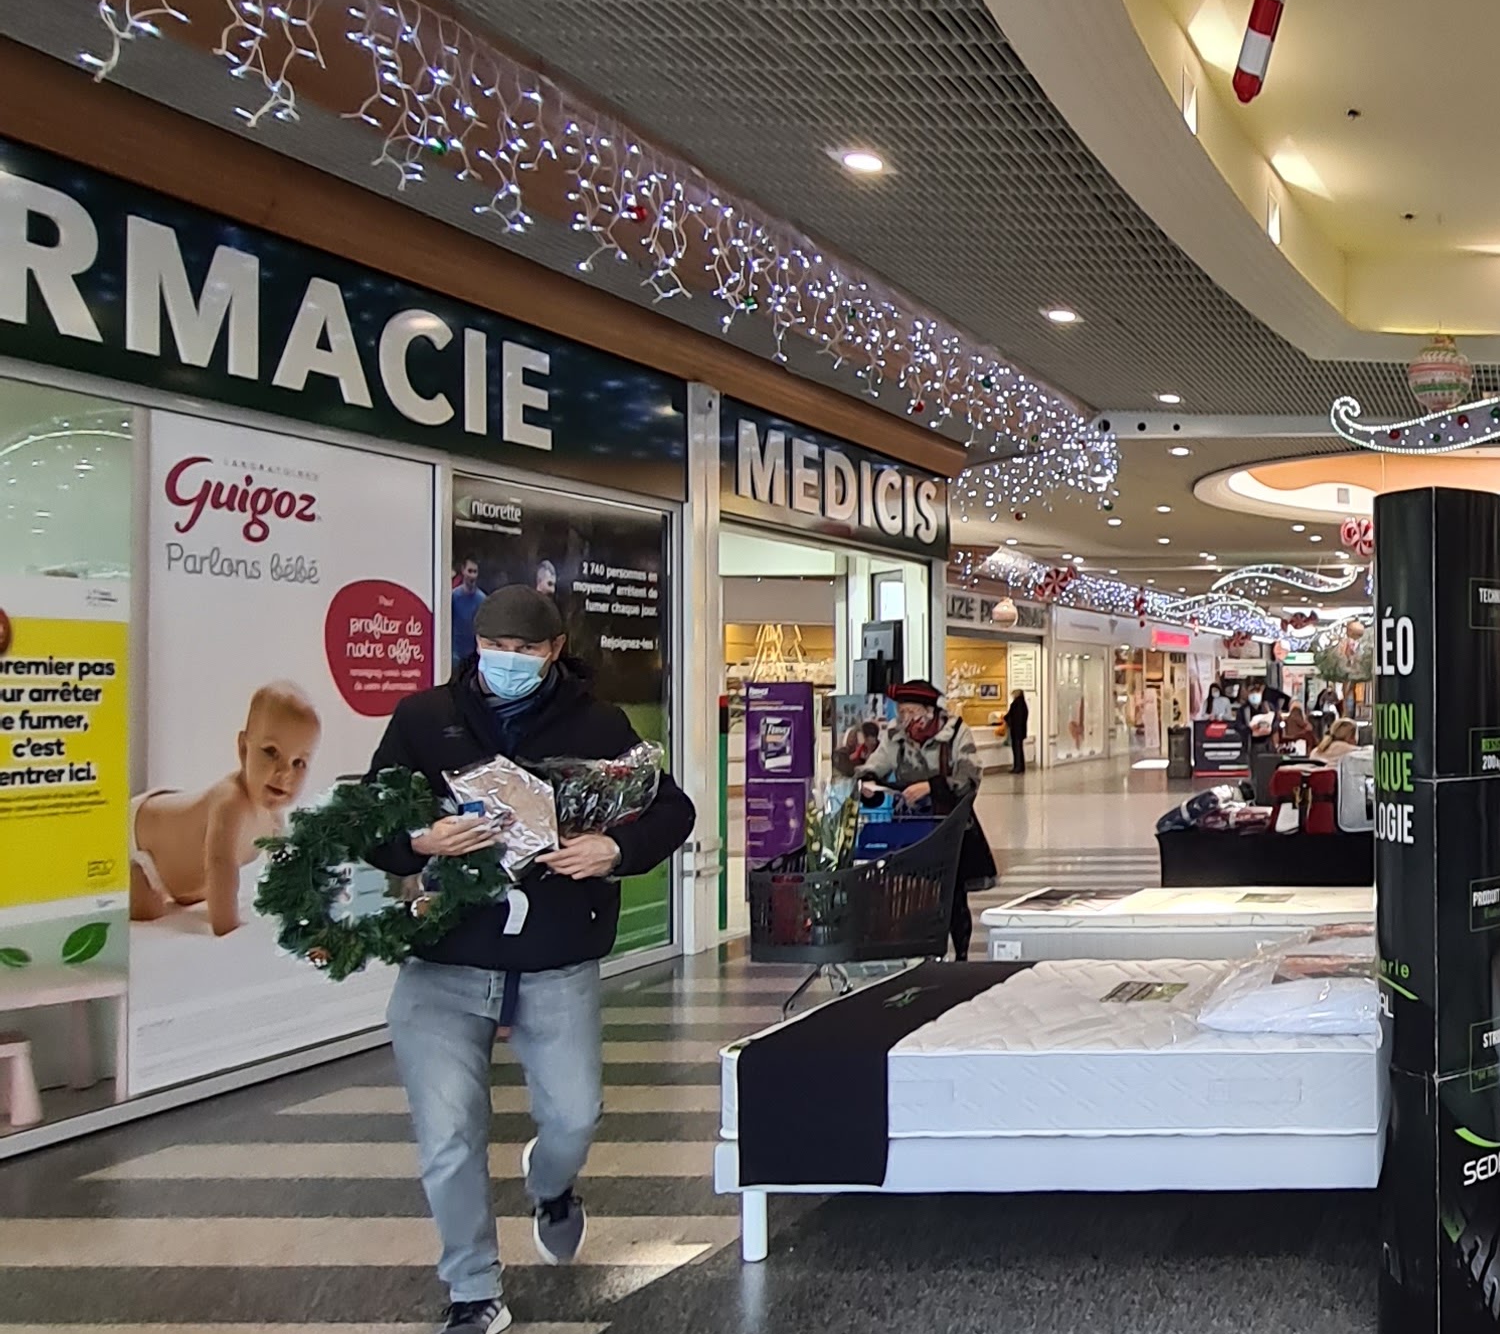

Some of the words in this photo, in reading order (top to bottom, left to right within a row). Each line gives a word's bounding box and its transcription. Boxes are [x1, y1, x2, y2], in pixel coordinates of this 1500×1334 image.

[0, 170, 553, 451] RMACIE
[737, 419, 938, 545] MEDICIS
[165, 456, 317, 543] Guigoz
[471, 499, 522, 523] nicorette
[166, 543, 261, 580] Parlons
[270, 553, 320, 584] bébé
[349, 612, 401, 640] profiter
[405, 616, 423, 636] de
[346, 640, 384, 658] notre
[387, 638, 424, 665] offre,
[78, 661, 116, 682] pas
[0, 688, 25, 703] ur
[29, 681, 102, 703] arrêter
[0, 715, 15, 731] e
[19, 709, 89, 732] fumer,
[12, 737, 66, 758] c'est
[69, 761, 97, 782] ici.
